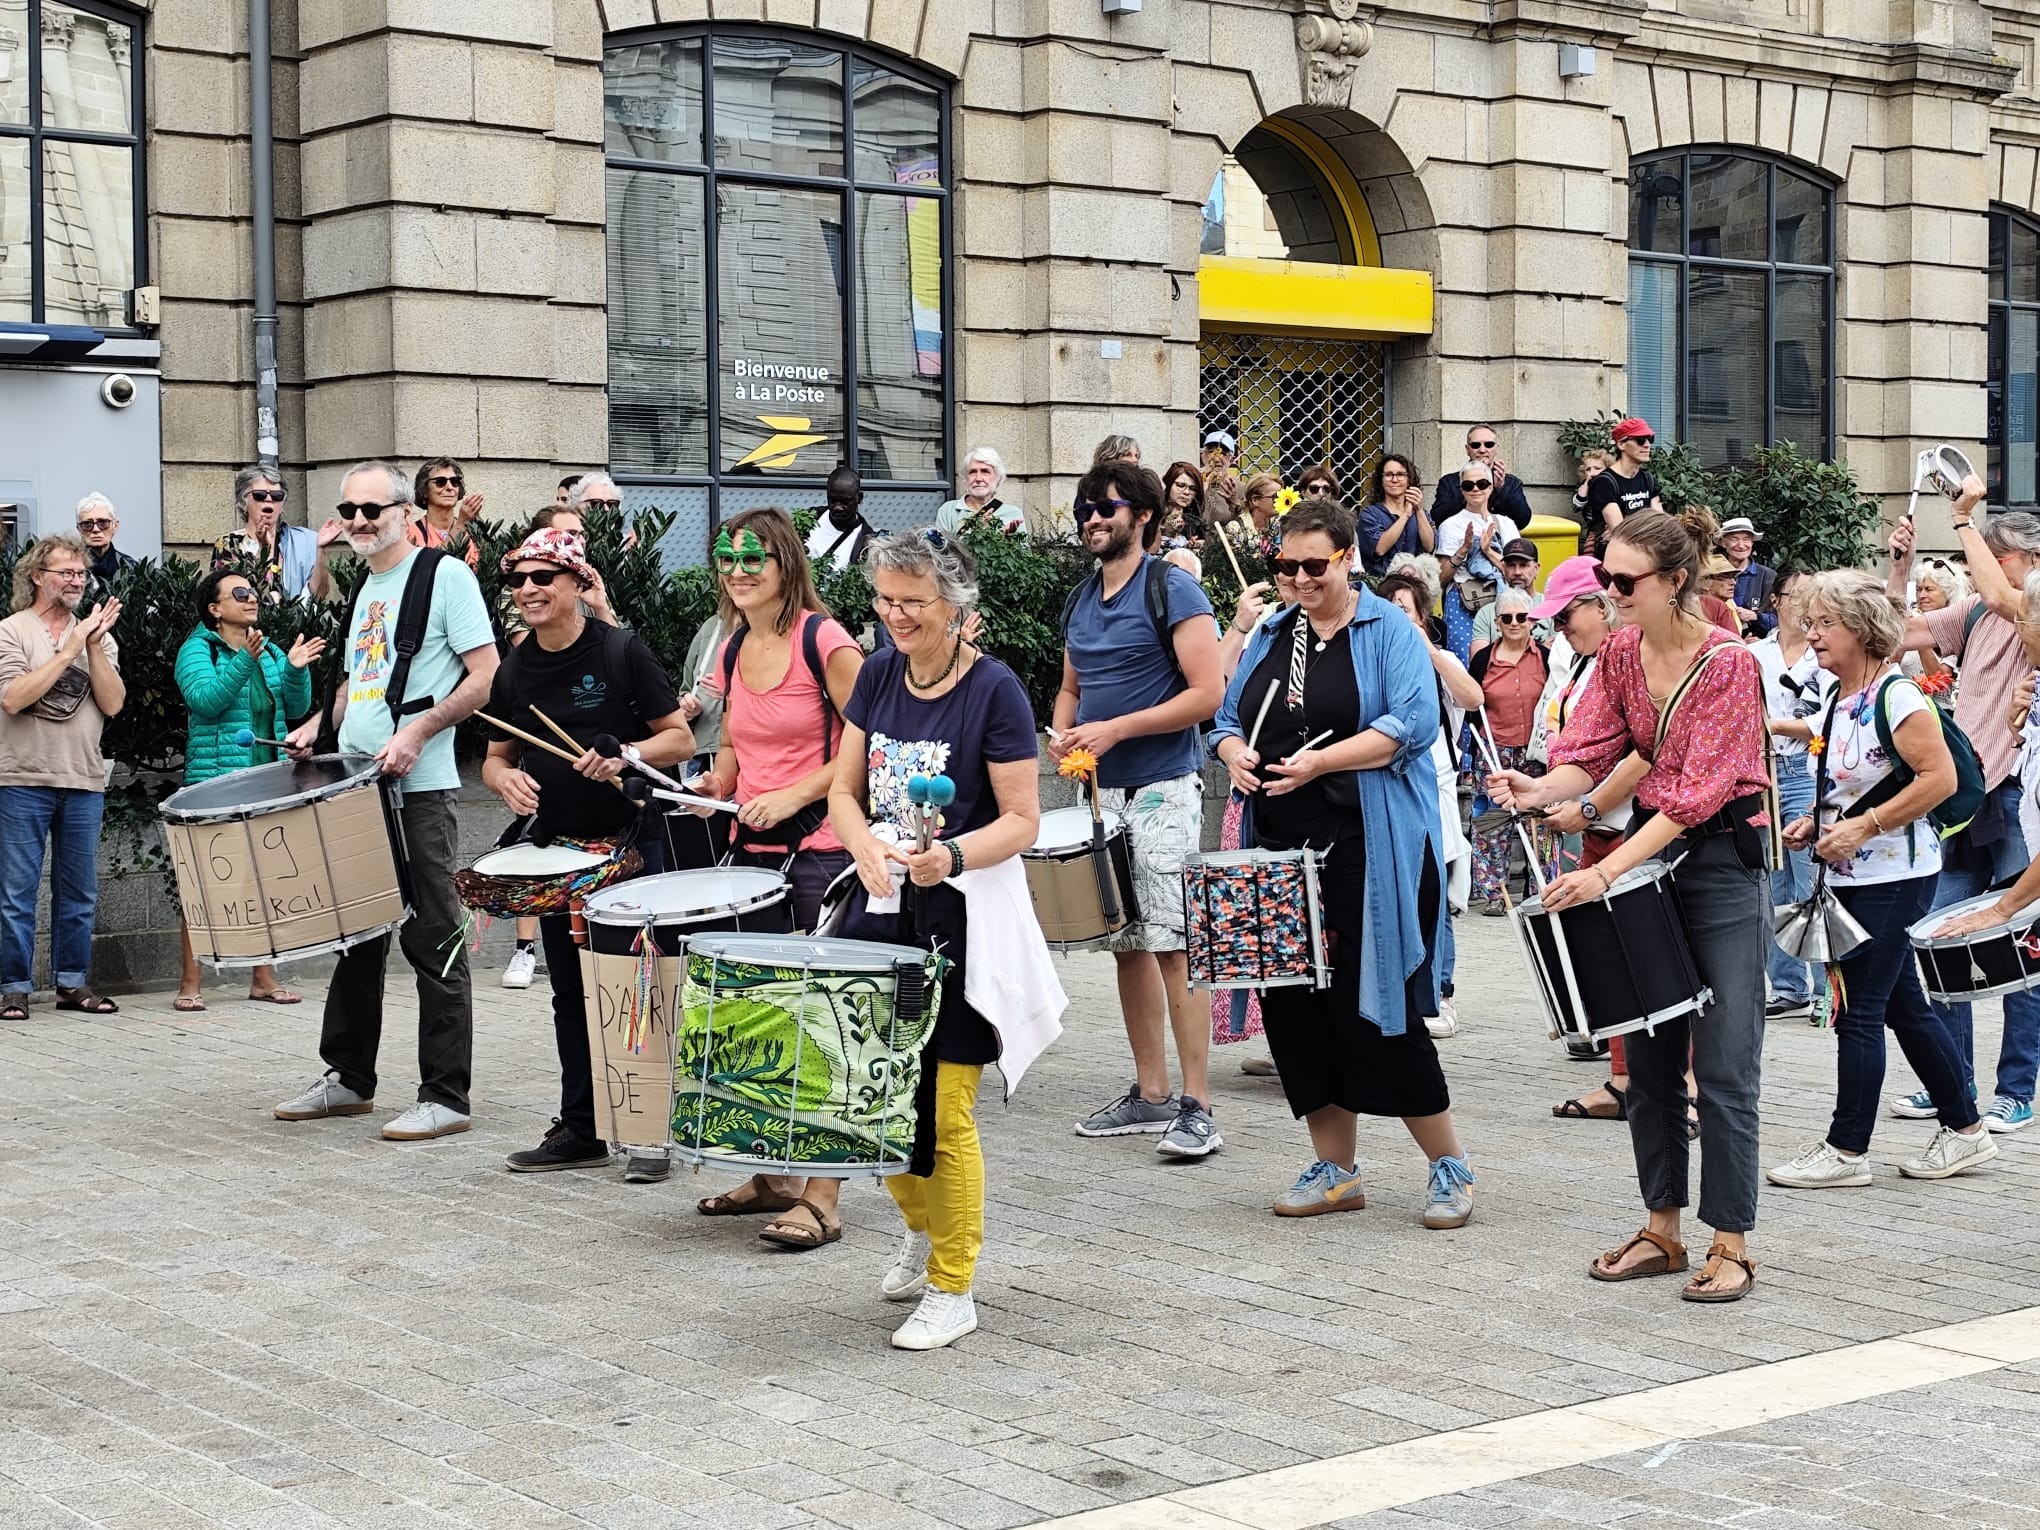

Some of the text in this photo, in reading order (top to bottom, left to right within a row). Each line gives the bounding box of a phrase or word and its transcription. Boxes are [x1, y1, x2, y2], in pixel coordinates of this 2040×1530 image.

[734, 358, 829, 381] Bienvenue
[735, 382, 825, 403] à La Poste
[605, 1062, 644, 1114] DE
